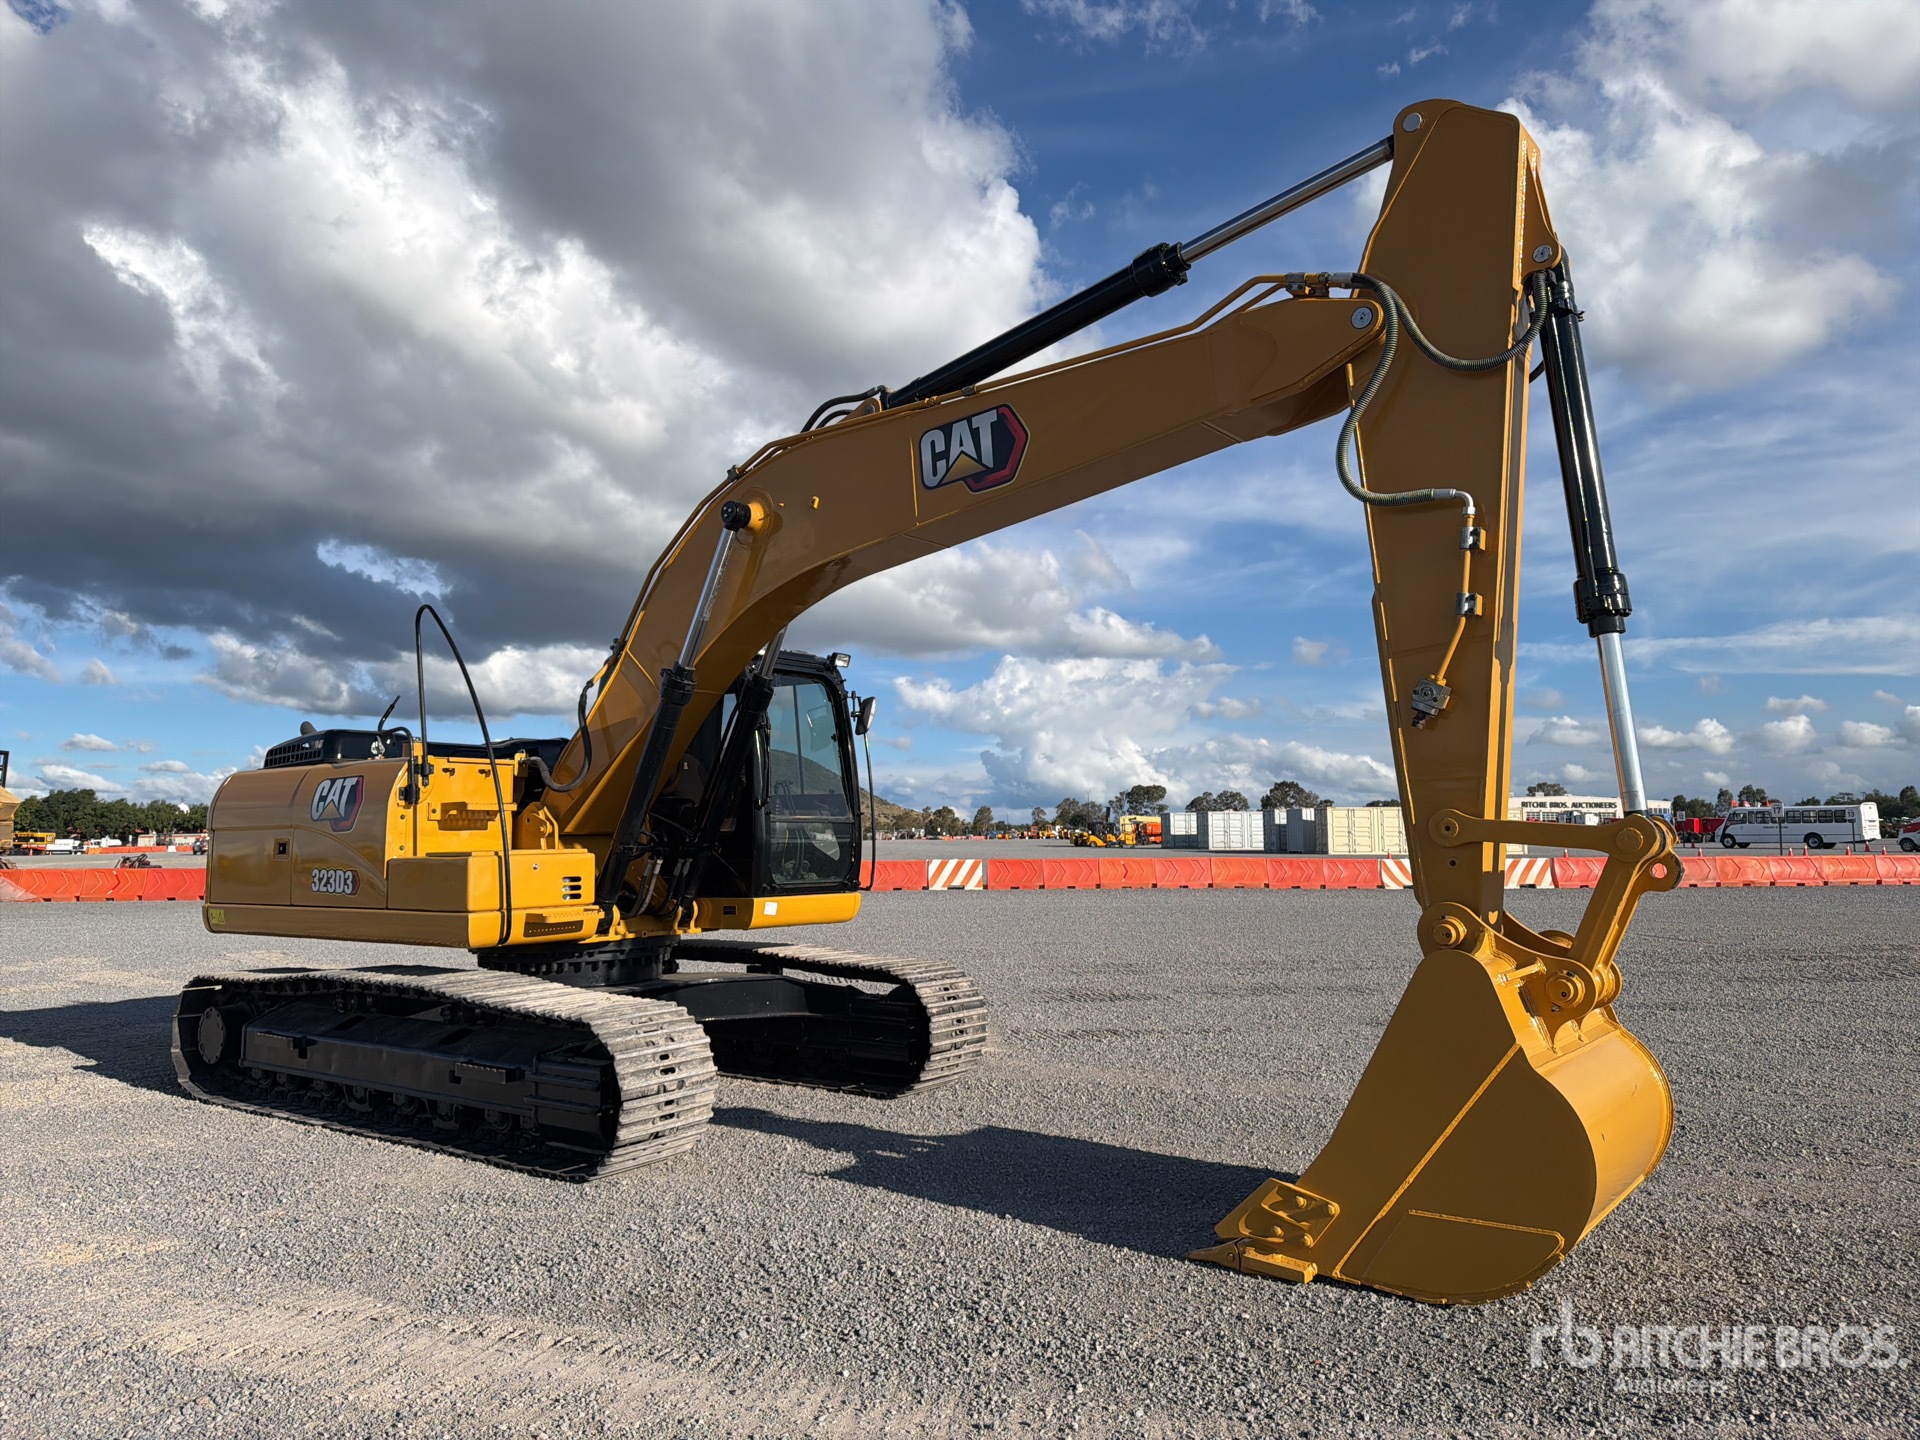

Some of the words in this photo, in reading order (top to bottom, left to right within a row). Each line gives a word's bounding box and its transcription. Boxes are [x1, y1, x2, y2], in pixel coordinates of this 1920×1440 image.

[920, 408, 998, 487] CAT
[311, 776, 359, 821] CAT
[1521, 801, 1548, 809] RITCHIE
[1549, 801, 1569, 809] BROS.
[1571, 801, 1618, 809] AUCTIONEERS
[1772, 806, 1781, 815] 17
[311, 869, 353, 894] 323D3
